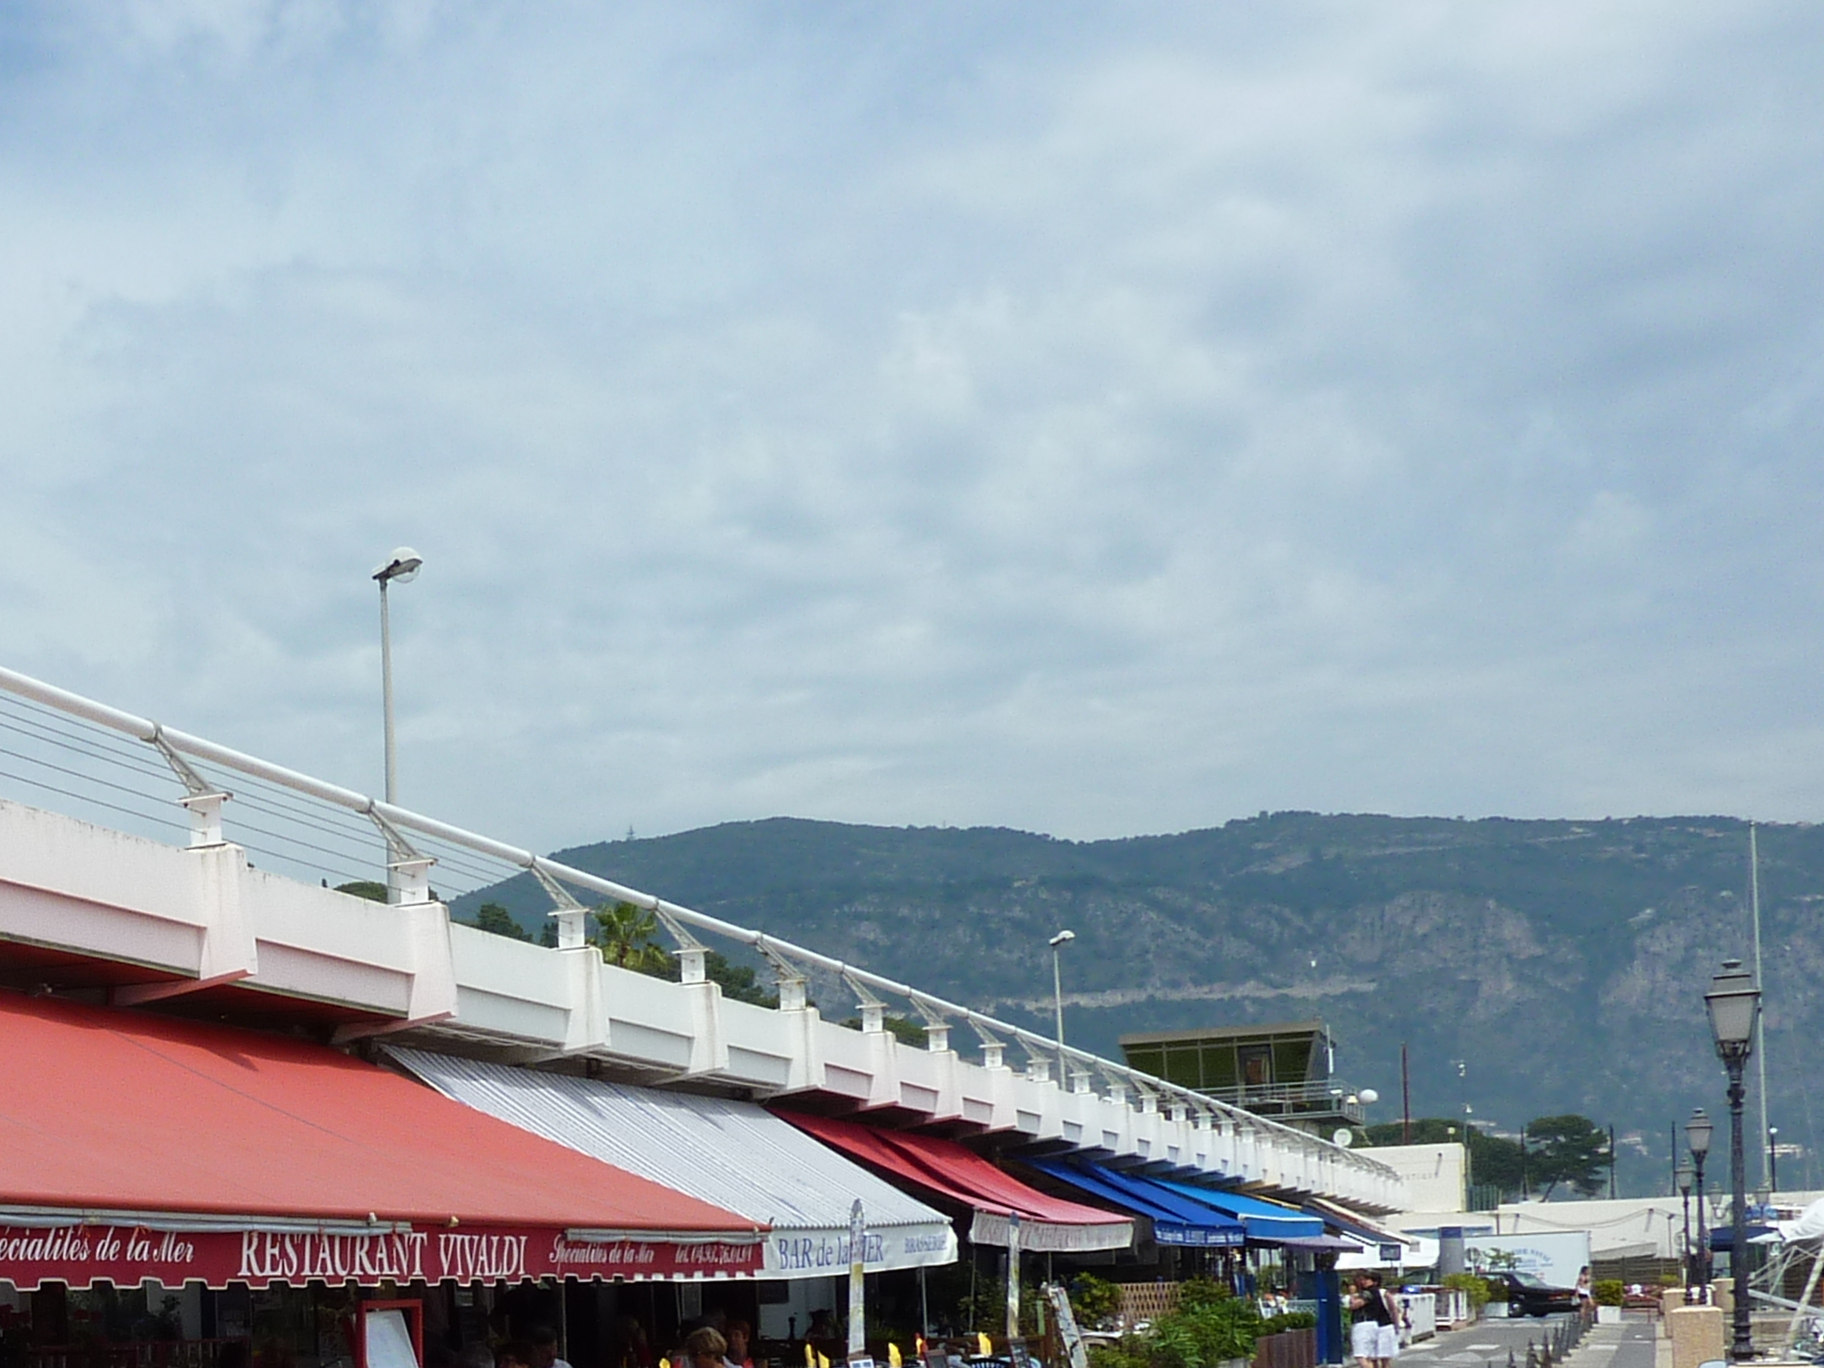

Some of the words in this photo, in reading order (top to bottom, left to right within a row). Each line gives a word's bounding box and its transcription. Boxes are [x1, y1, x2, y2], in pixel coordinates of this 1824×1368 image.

[95, 1225, 121, 1261] de
[126, 1225, 150, 1262] la
[152, 1238, 195, 1264] Mer
[237, 1231, 428, 1278] RESTAURANT
[438, 1234, 528, 1276] VIVALDI
[778, 1238, 813, 1270] BAR
[816, 1240, 833, 1266] de
